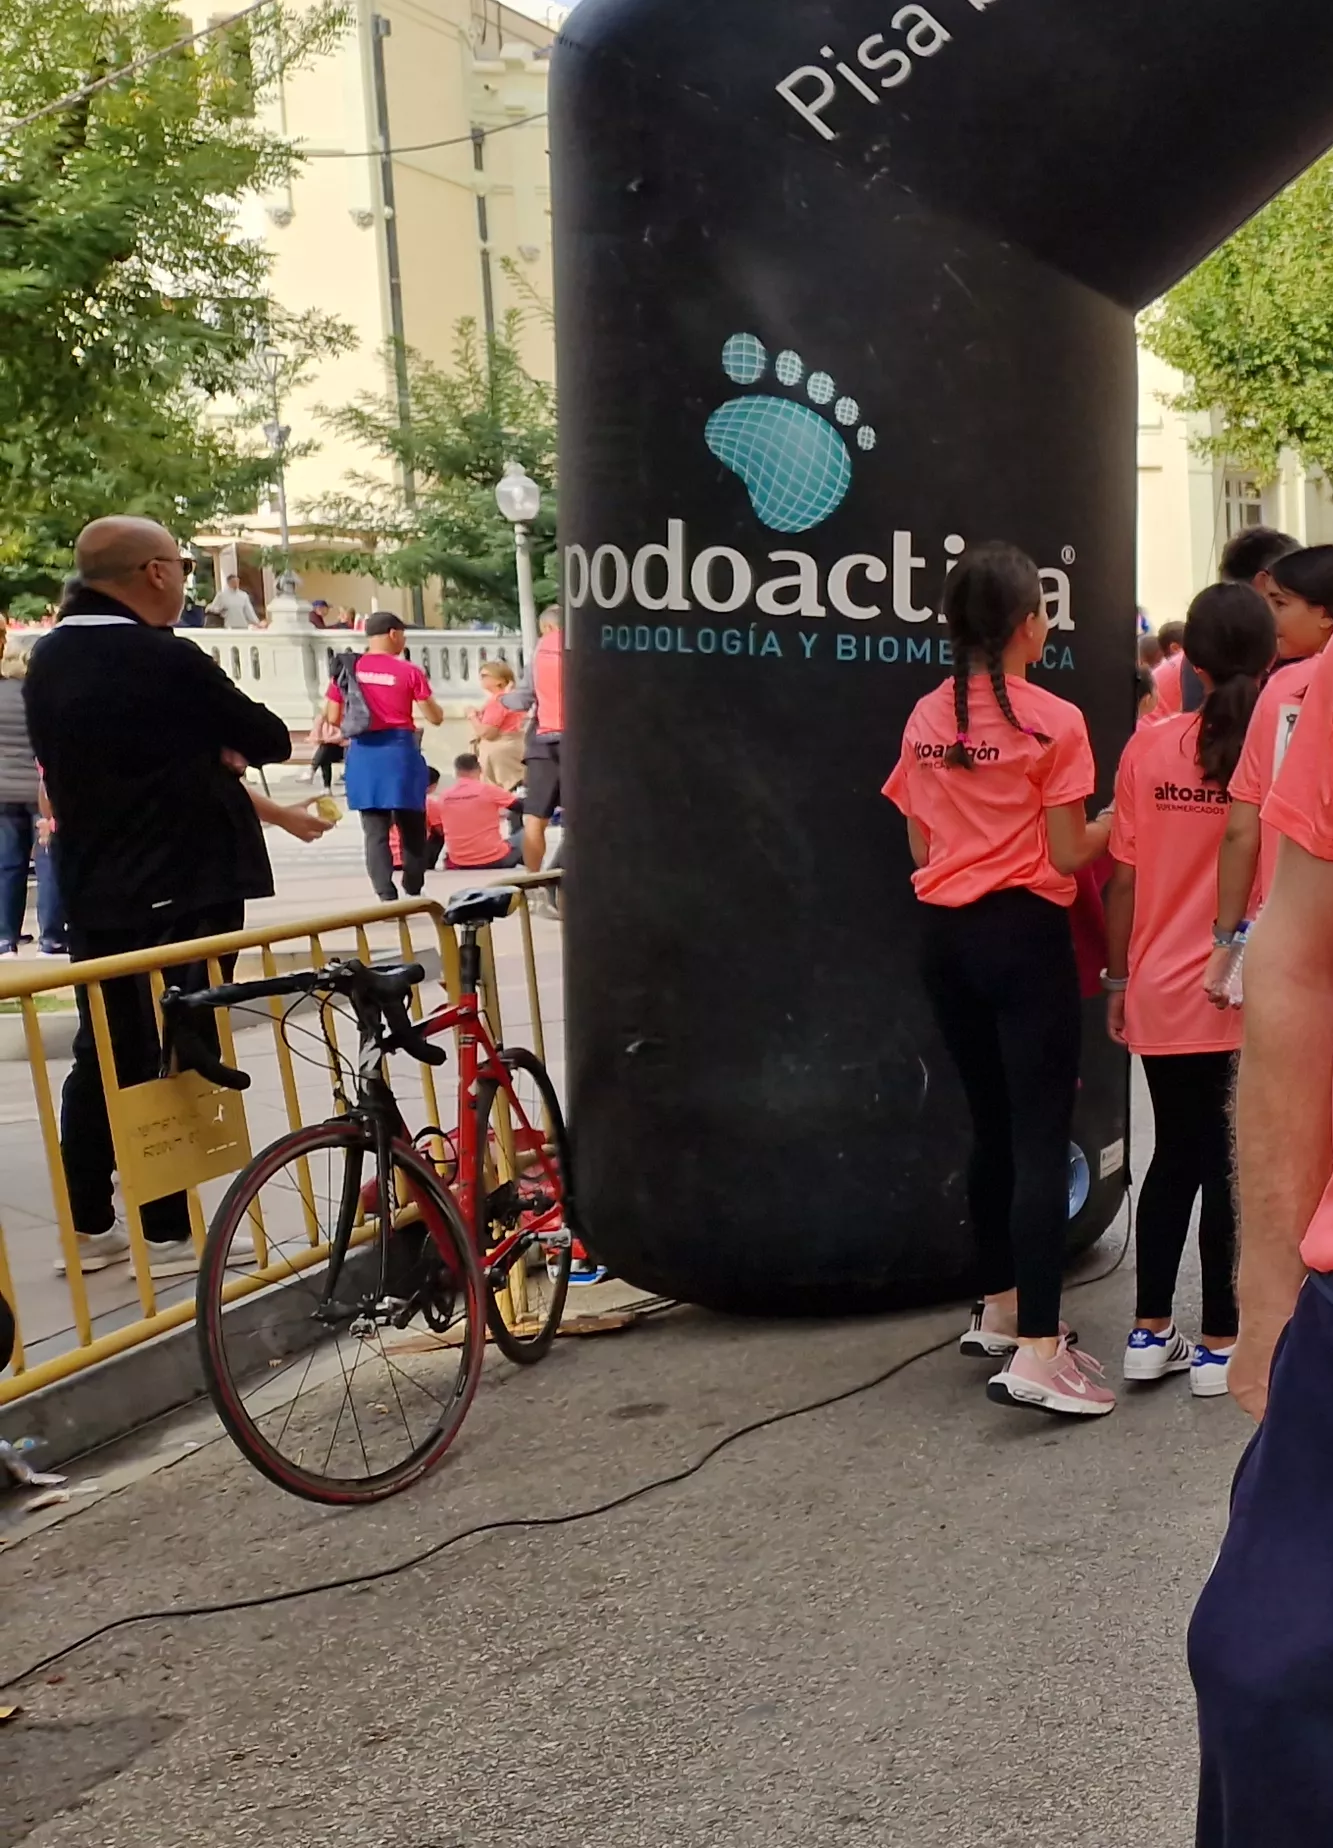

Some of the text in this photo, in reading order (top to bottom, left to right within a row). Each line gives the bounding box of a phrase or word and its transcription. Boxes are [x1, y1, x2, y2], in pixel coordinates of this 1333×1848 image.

[775, 4, 953, 141] Pisa
[564, 517, 1076, 650] podoacta
[601, 621, 1075, 670] PODOLOGÍA Y BIOMECA
[1154, 781, 1233, 804] altoara
